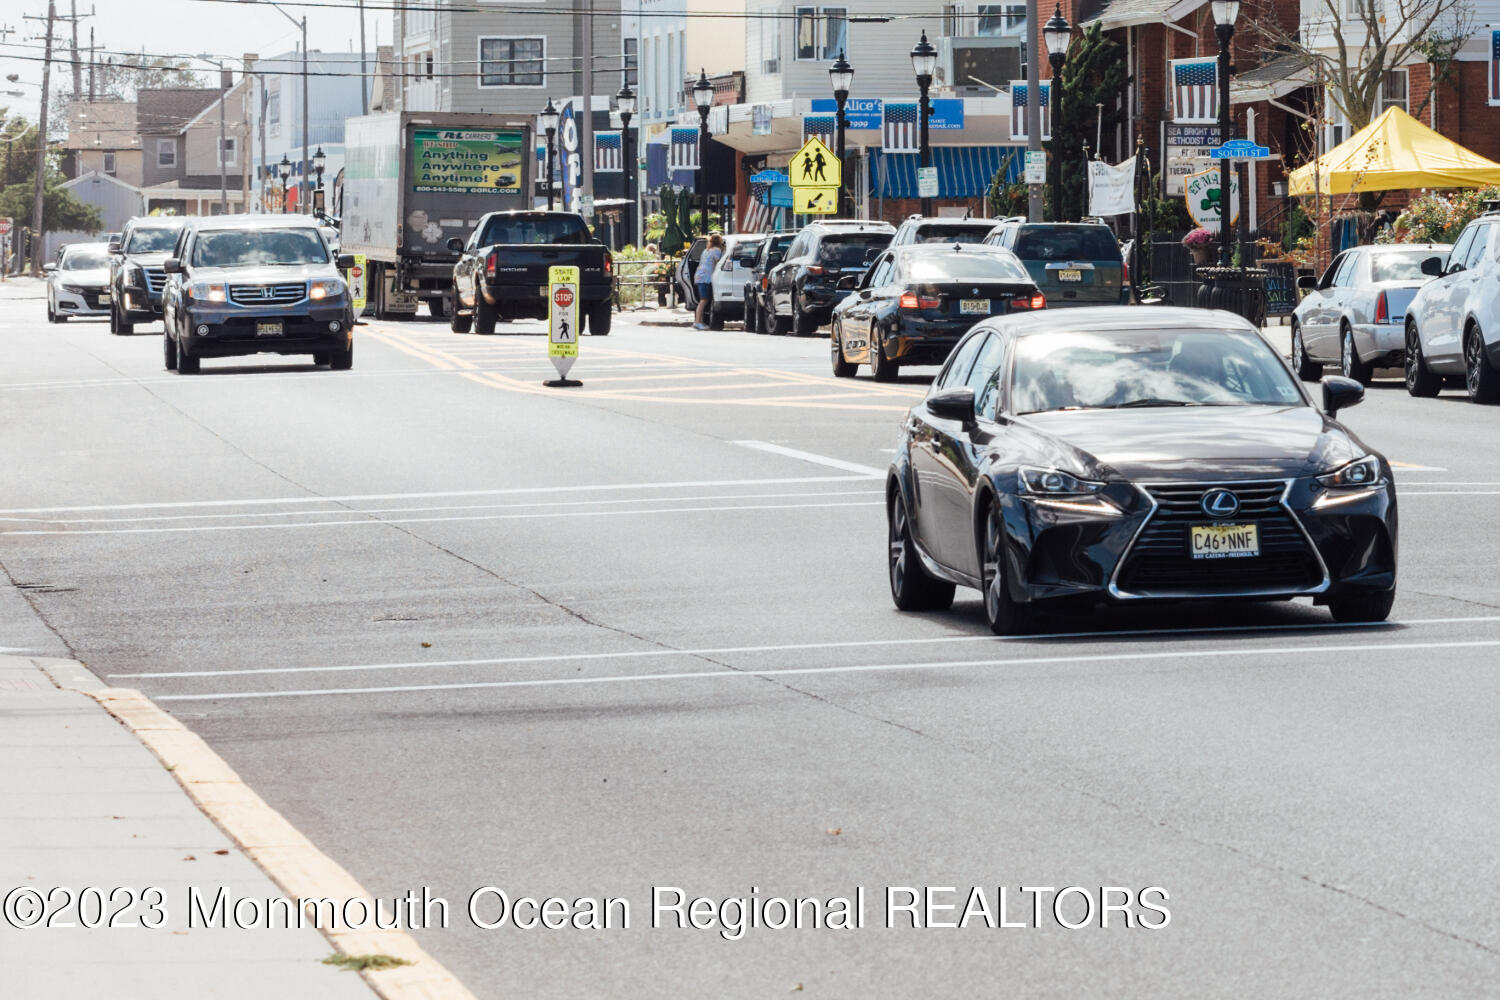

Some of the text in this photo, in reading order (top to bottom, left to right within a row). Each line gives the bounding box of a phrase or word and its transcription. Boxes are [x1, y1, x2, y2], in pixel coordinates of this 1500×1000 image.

[843, 99, 882, 111] Alice's
[1168, 127, 1182, 136] SEA
[1184, 127, 1208, 136] BRIGHT
[1167, 136, 1204, 145] METHODIST
[422, 150, 488, 161] Anything
[1217, 149, 1261, 157] SOUTH ST
[422, 162, 500, 172] Anywhere
[1169, 168, 1195, 176] TUESDAY
[422, 173, 489, 183] Anytime!
[554, 268, 574, 276] STATE
[555, 293, 573, 302] STOP
